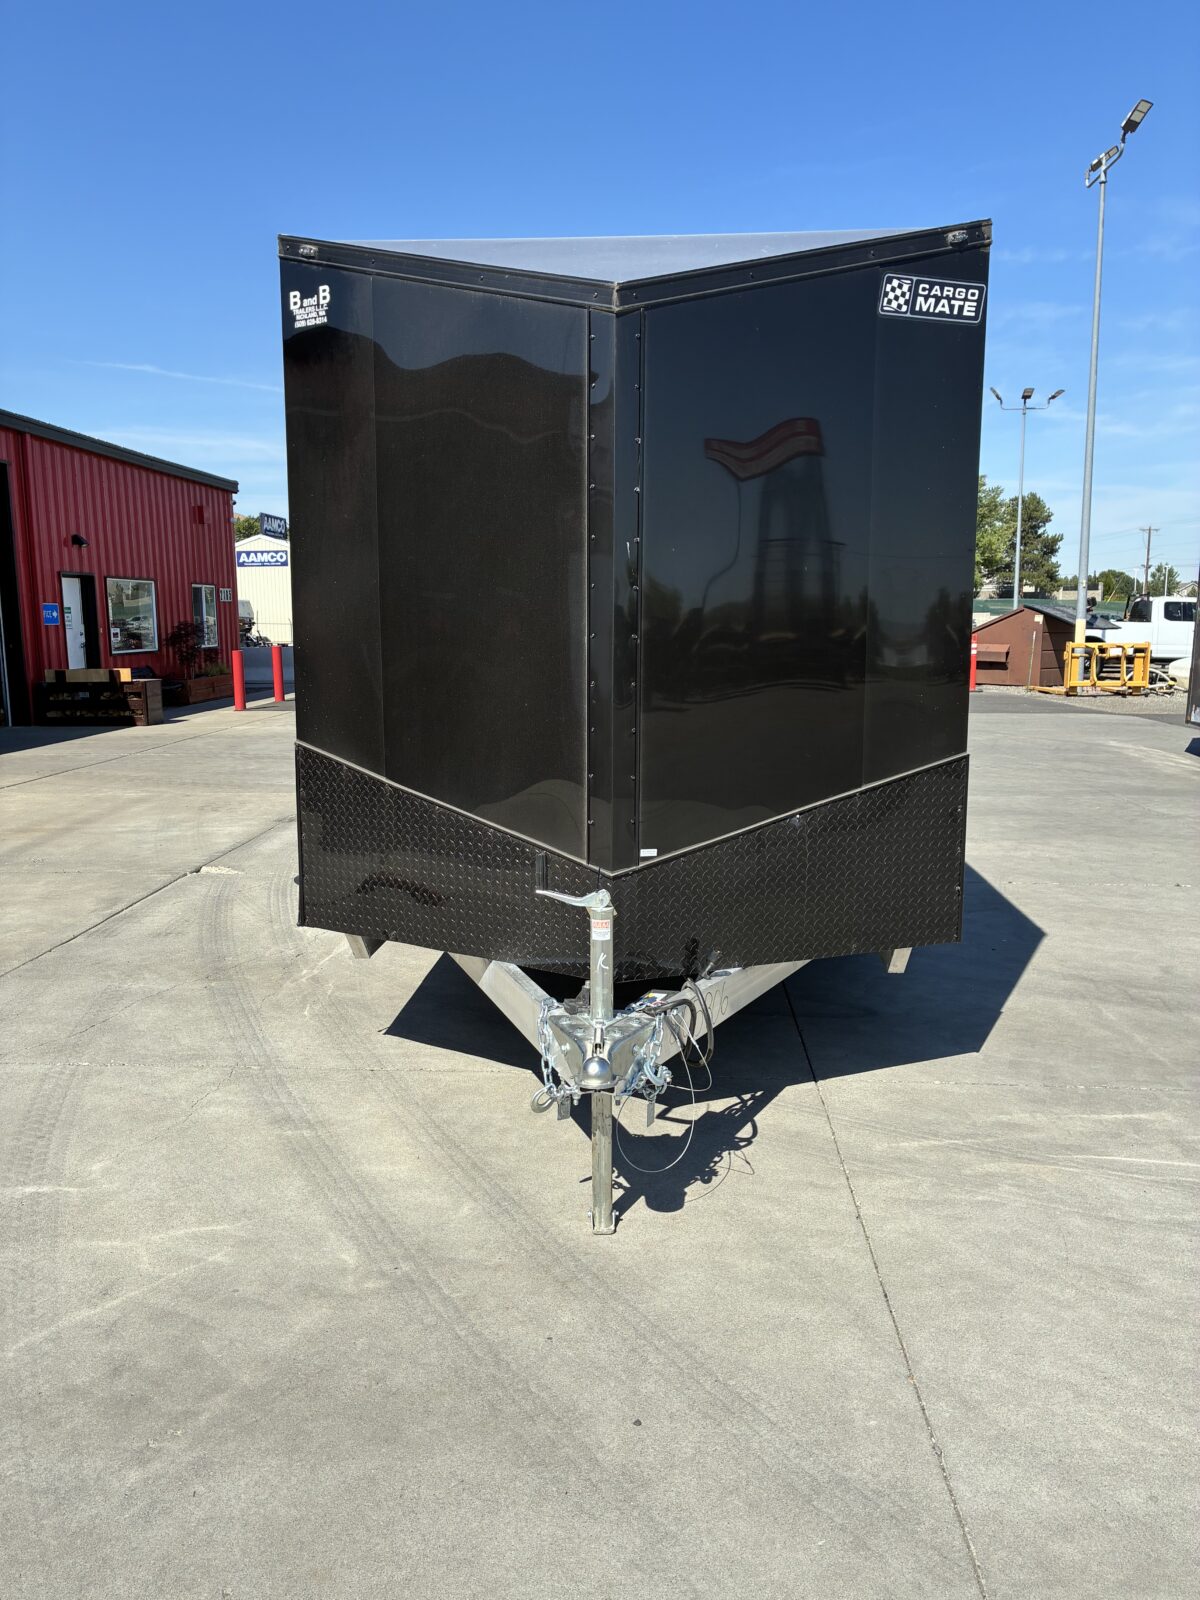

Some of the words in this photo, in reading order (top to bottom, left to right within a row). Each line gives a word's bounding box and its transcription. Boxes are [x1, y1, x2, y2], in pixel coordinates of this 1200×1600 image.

[290, 291, 301, 310] B
[303, 294, 317, 307] and
[319, 285, 330, 304] B
[918, 284, 979, 300] CARGO
[915, 296, 977, 316] MATE
[263, 516, 286, 534] AAMCO
[239, 552, 287, 563] AAMCO
